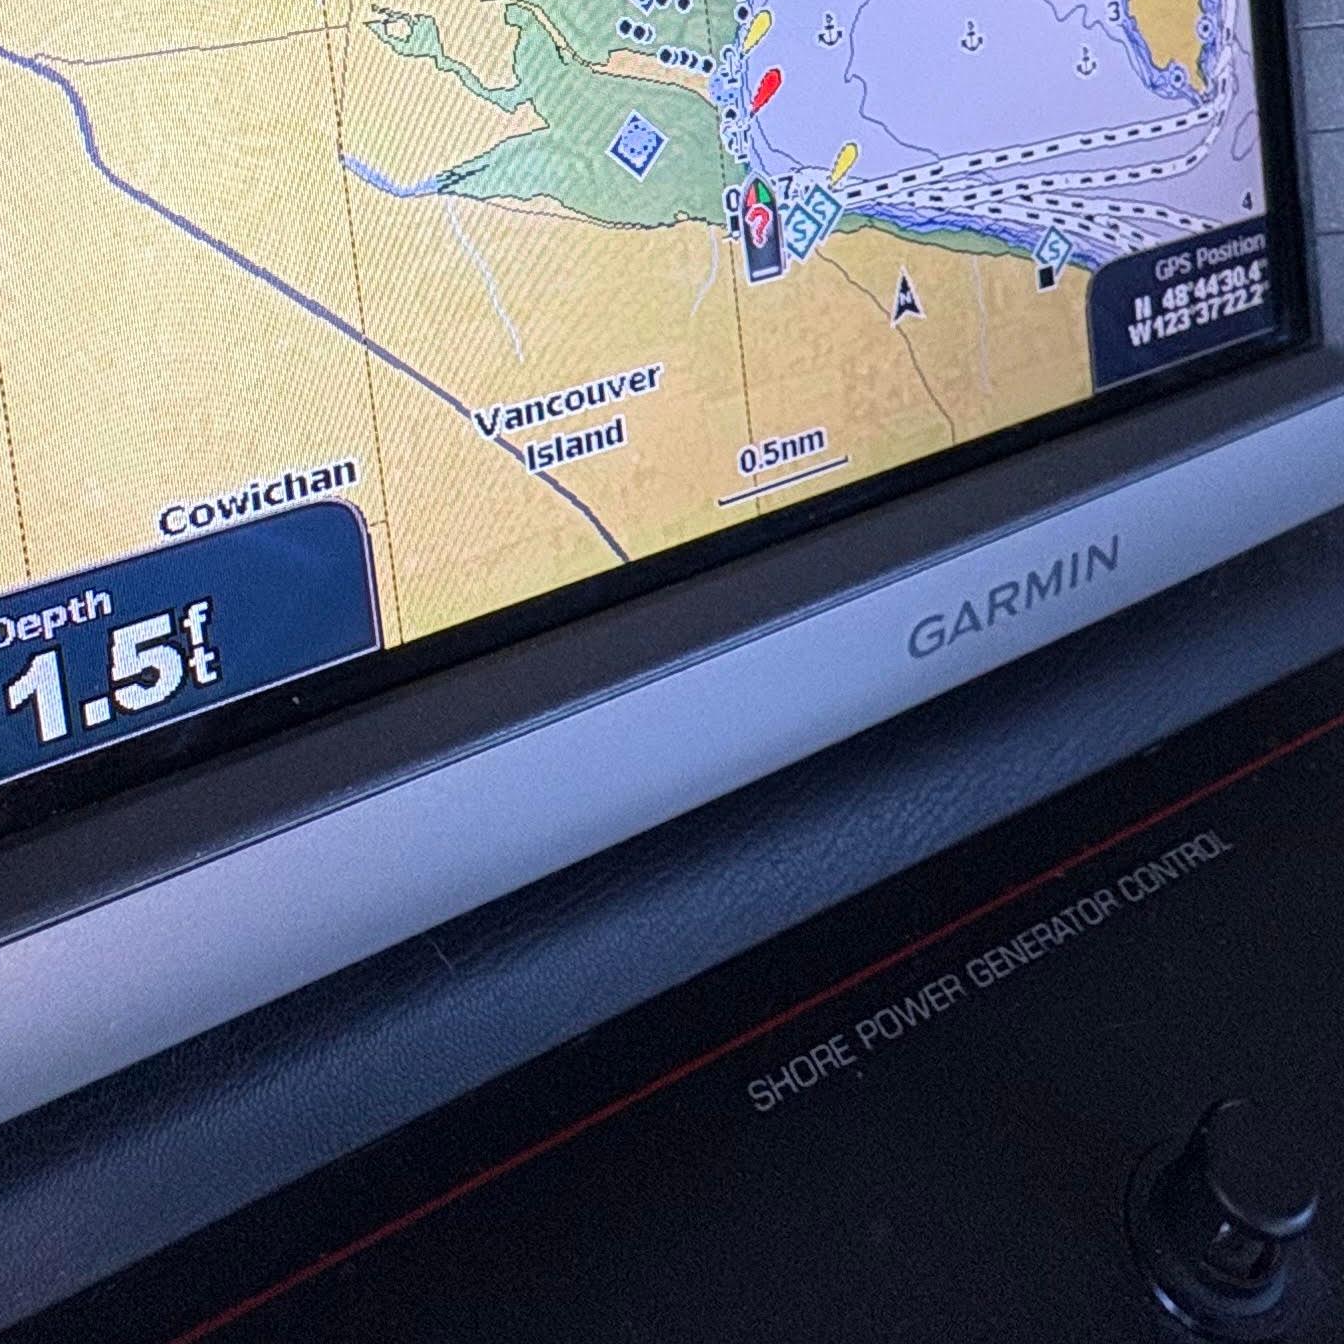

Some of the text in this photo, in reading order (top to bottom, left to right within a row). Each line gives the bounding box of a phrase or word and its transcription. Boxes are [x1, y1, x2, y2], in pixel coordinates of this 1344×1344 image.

[1155, 232, 1267, 281] GPS Position
[475, 363, 663, 437] Vancouver
[526, 419, 624, 471] Island
[738, 429, 825, 474] 0.5nm
[158, 460, 358, 537] Cowichan
[907, 534, 1119, 659] GARMIN
[8, 613, 183, 743] 1.5
[746, 828, 1234, 1113] SHORE POWER GENERATOR CONTROL
